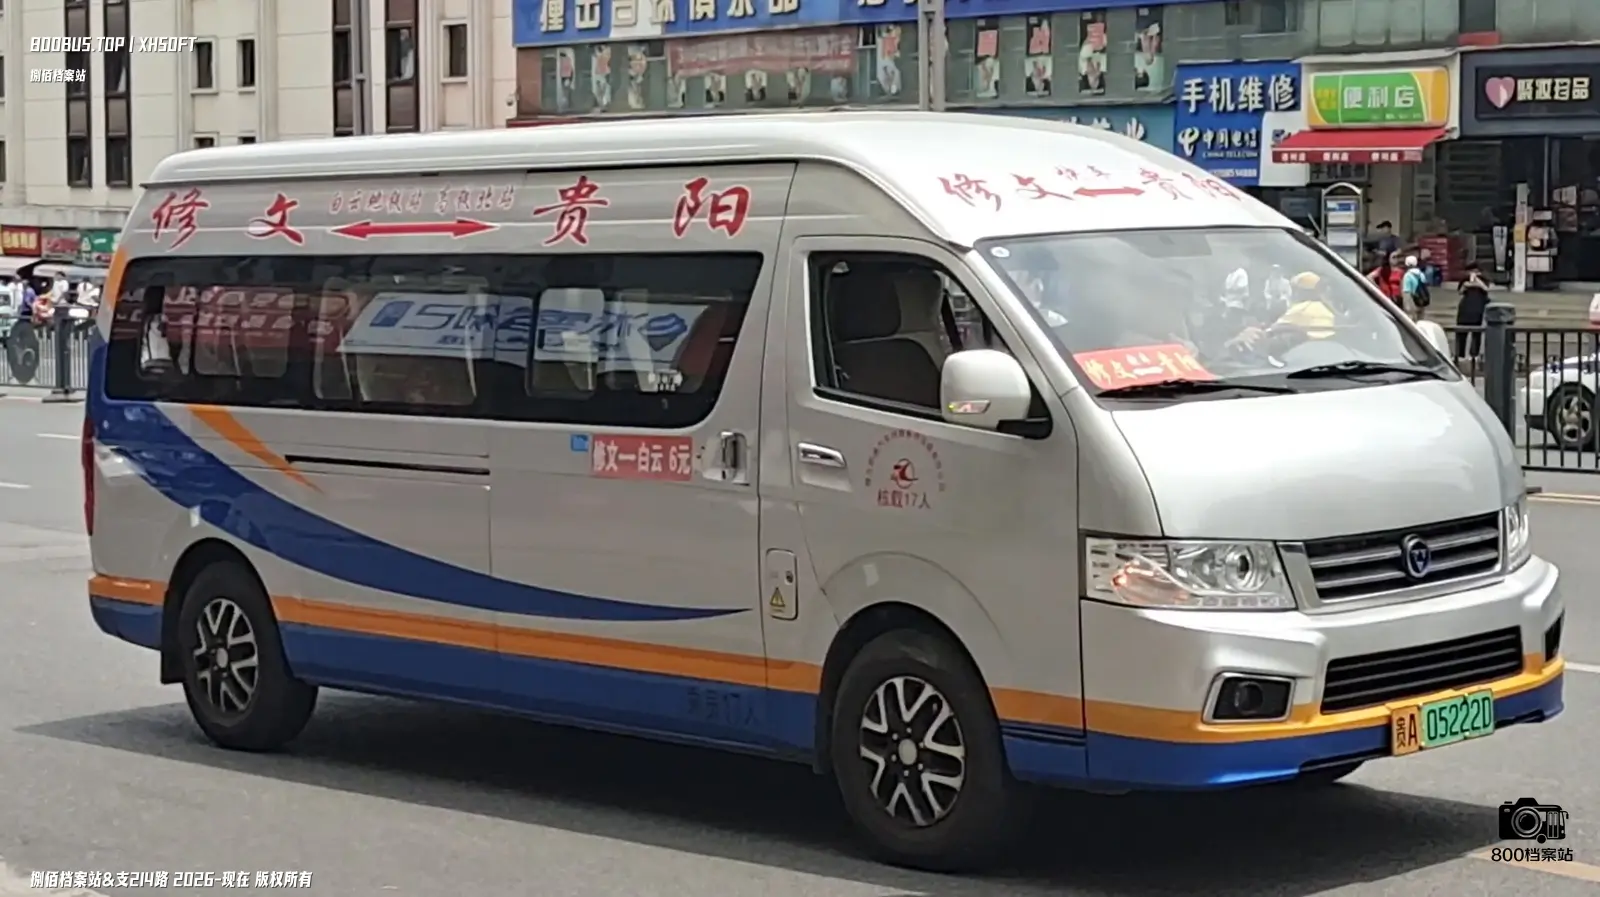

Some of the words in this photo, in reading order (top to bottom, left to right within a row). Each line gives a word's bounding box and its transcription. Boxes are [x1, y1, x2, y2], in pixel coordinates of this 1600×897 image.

[1181, 74, 1295, 113] 手机维修
[1343, 85, 1415, 109] 便利店
[1203, 127, 1258, 149] 中国电信
[938, 173, 1076, 212] 修文
[151, 187, 304, 251] 修文
[533, 175, 751, 246] 贵阳
[669, 444, 691, 475] 6元
[1427, 696, 1492, 741] 05222D
